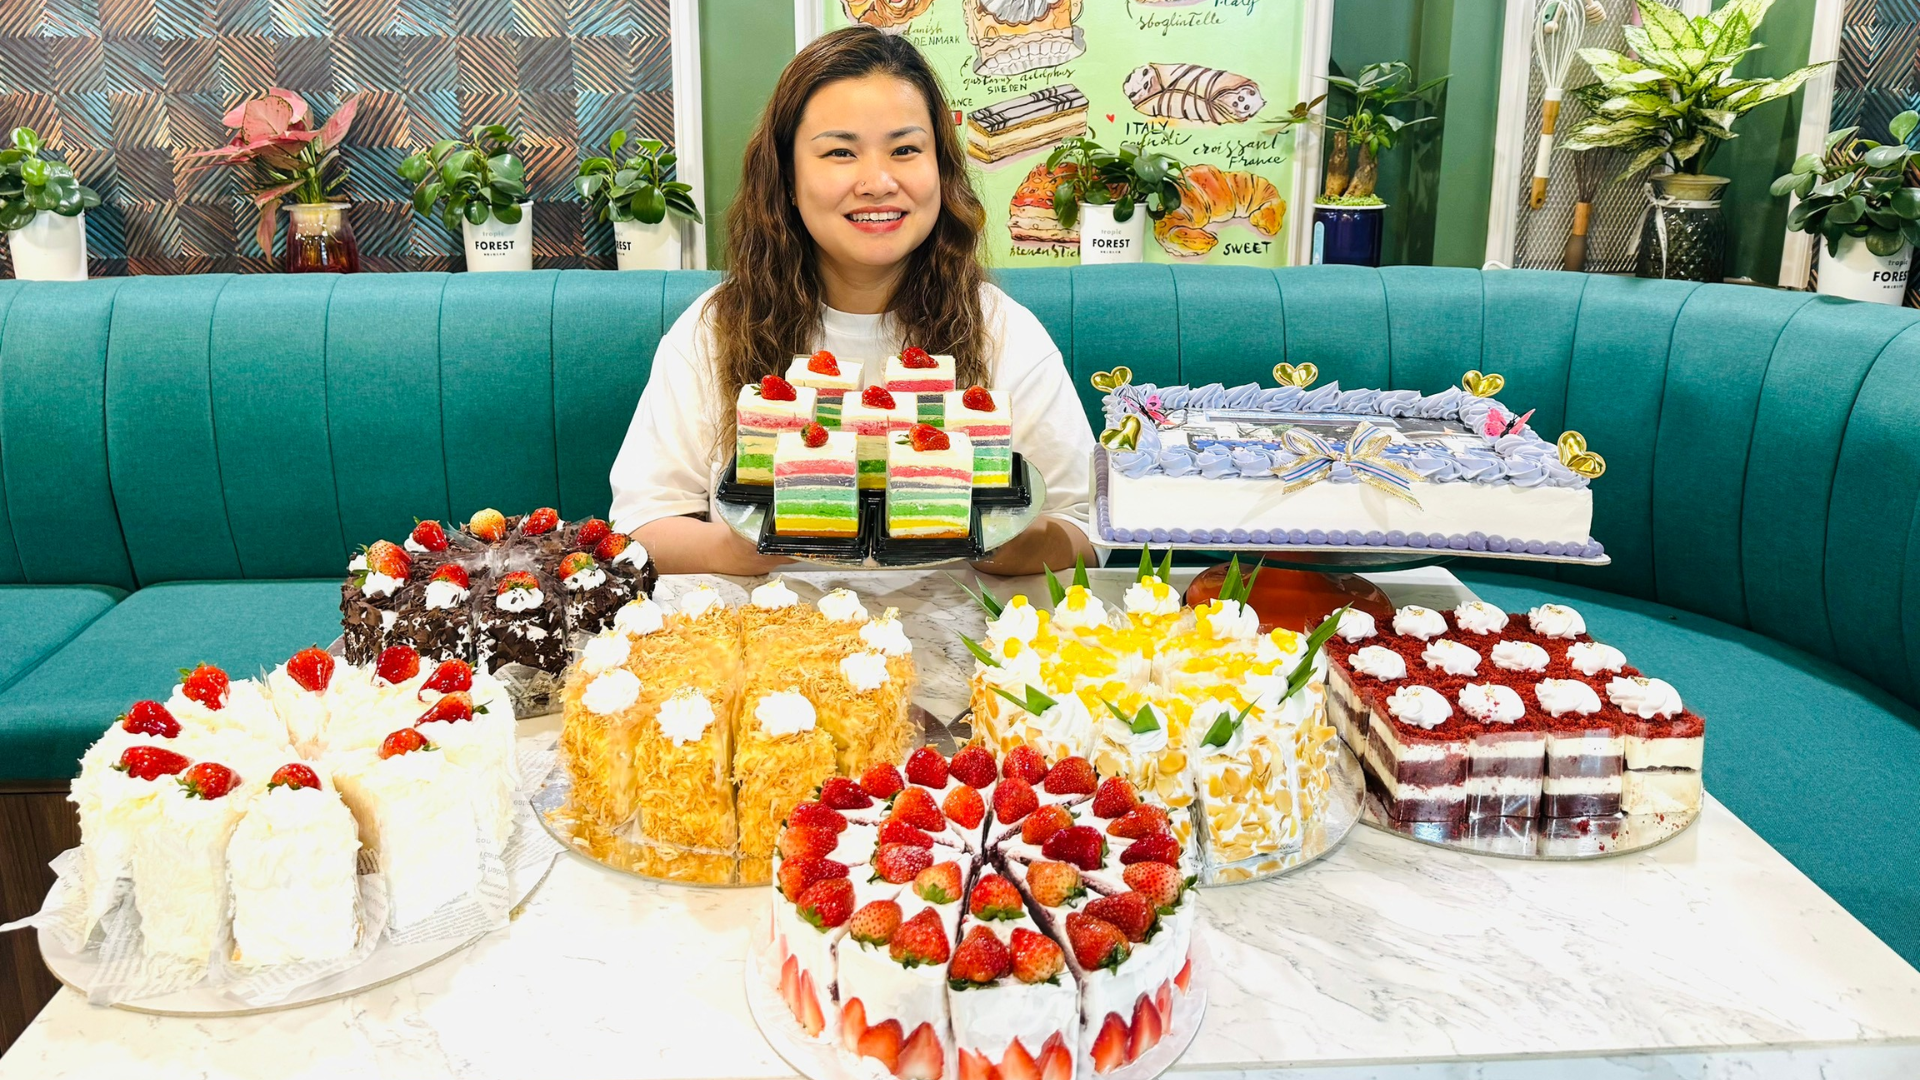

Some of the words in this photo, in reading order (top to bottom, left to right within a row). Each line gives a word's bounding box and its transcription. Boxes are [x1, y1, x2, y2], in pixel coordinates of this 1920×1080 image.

[913, 34, 961, 47] DENMARK
[946, 97, 974, 108] ANCE
[1126, 119, 1169, 136] ITALY
[1228, 155, 1287, 169] France
[482, 230, 505, 238] tropic
[1101, 228, 1122, 236] tropic
[475, 240, 515, 250] FOREST
[1092, 238, 1130, 248] FOREST
[1222, 241, 1272, 256] SWEET
[1872, 270, 1909, 282] FORES
